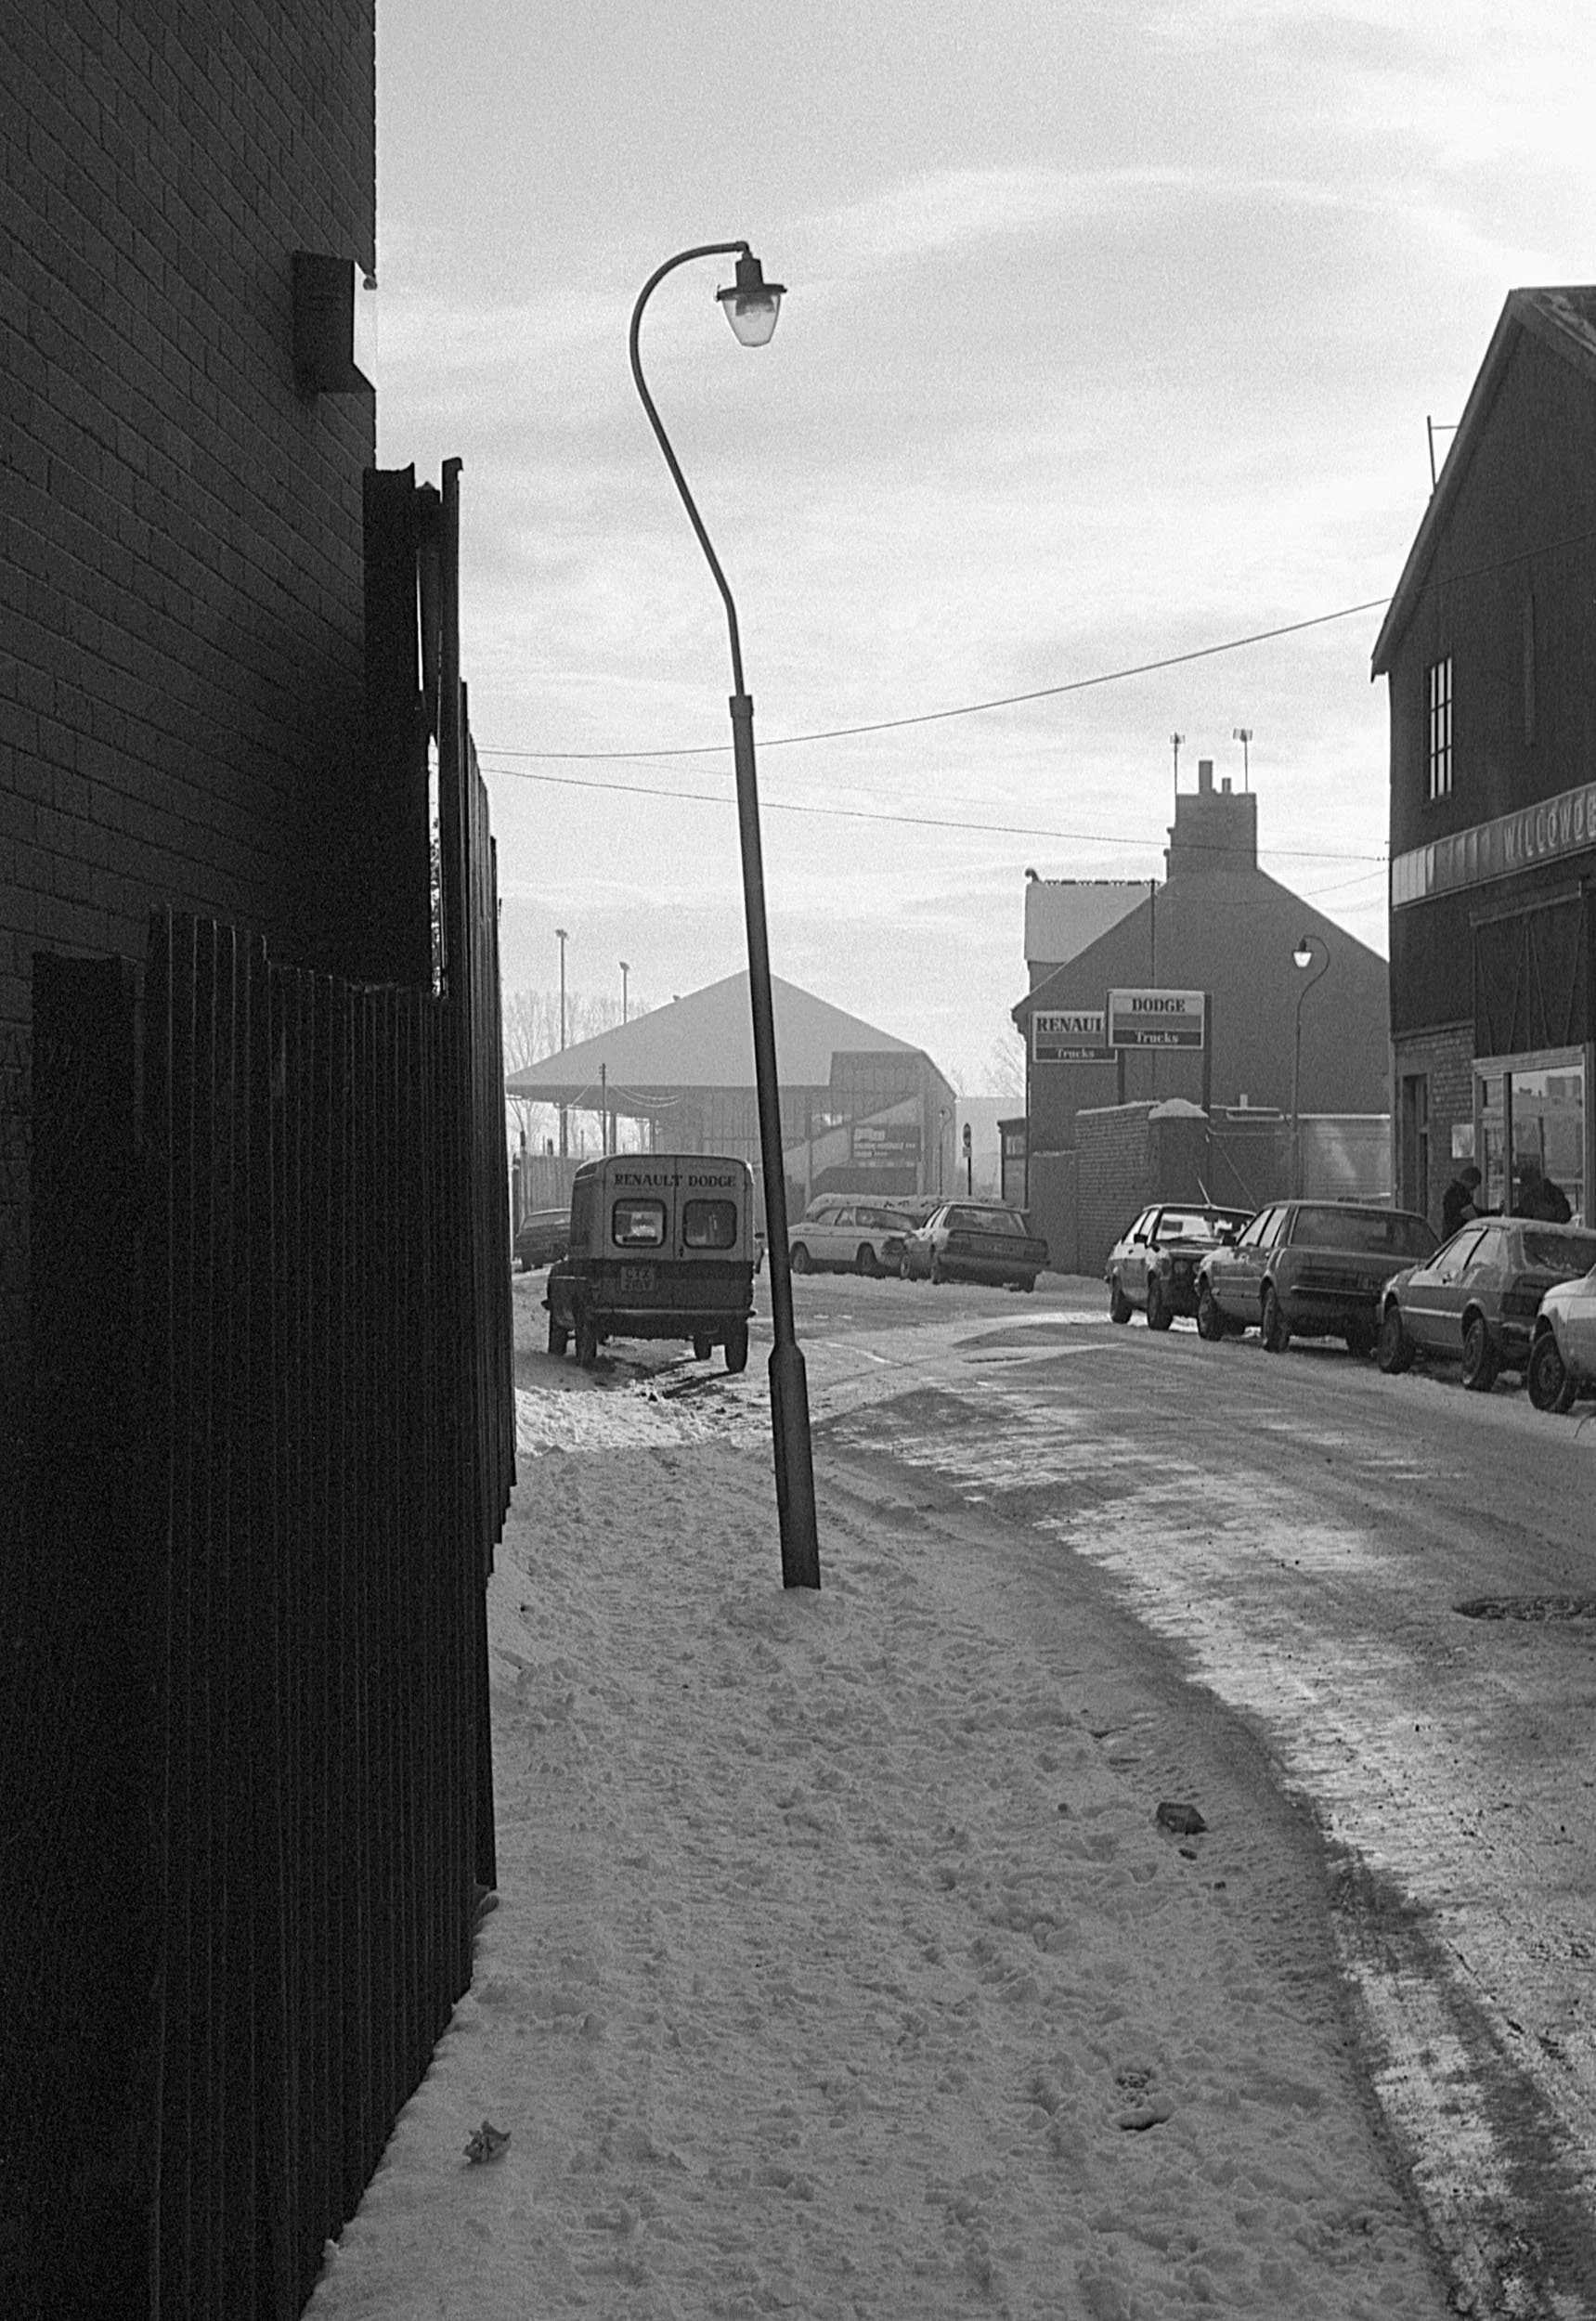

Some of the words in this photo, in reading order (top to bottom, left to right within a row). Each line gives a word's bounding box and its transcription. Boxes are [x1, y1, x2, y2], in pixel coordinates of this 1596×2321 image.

[1132, 998, 1186, 1013] DODGE
[1035, 1018, 1105, 1032] RENAUL
[1135, 1031, 1179, 1044] Trucks
[1057, 1048, 1096, 1058] Trucks
[615, 1173, 682, 1187] RENAULT
[688, 1174, 736, 1187] DODGE
